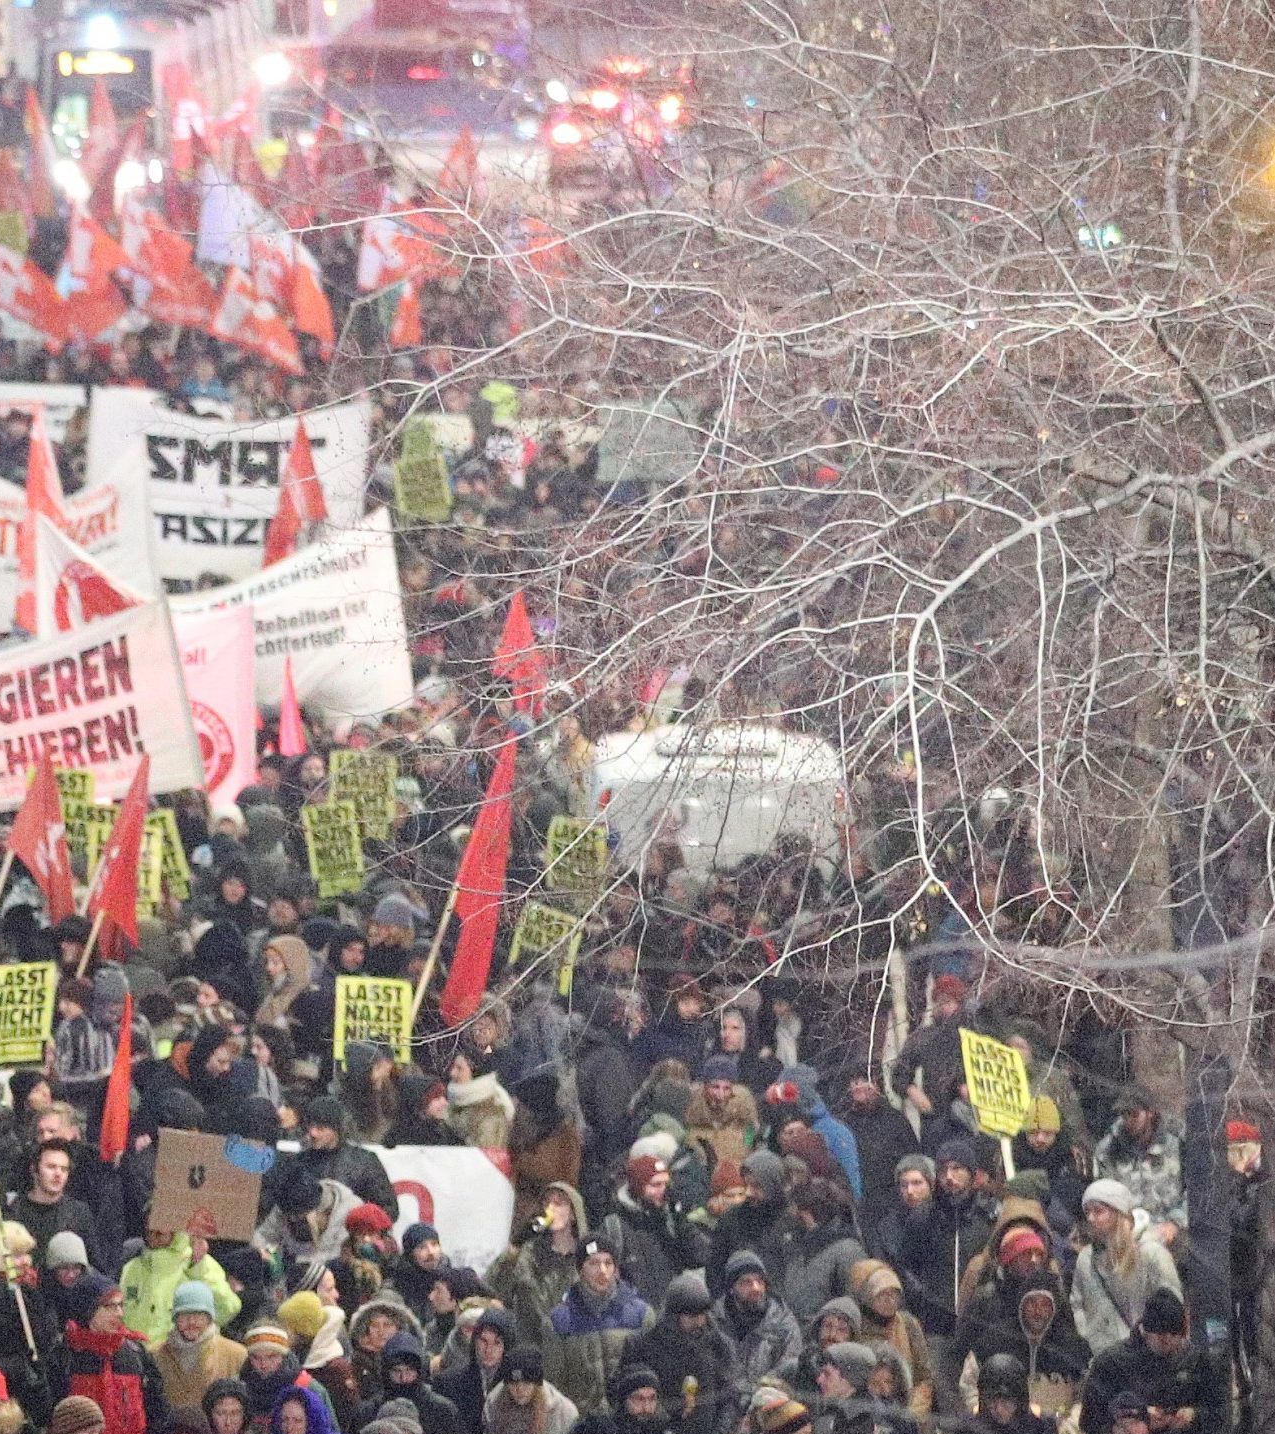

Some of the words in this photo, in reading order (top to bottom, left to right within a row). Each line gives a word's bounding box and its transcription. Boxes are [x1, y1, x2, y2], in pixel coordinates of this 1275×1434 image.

[344, 985, 403, 1001] LASST
[345, 1005, 403, 1022] NAZIS
[968, 1037, 1014, 1067] LASST
[970, 1056, 1020, 1085] NAZIS
[973, 1077, 1021, 1104] NICHT
